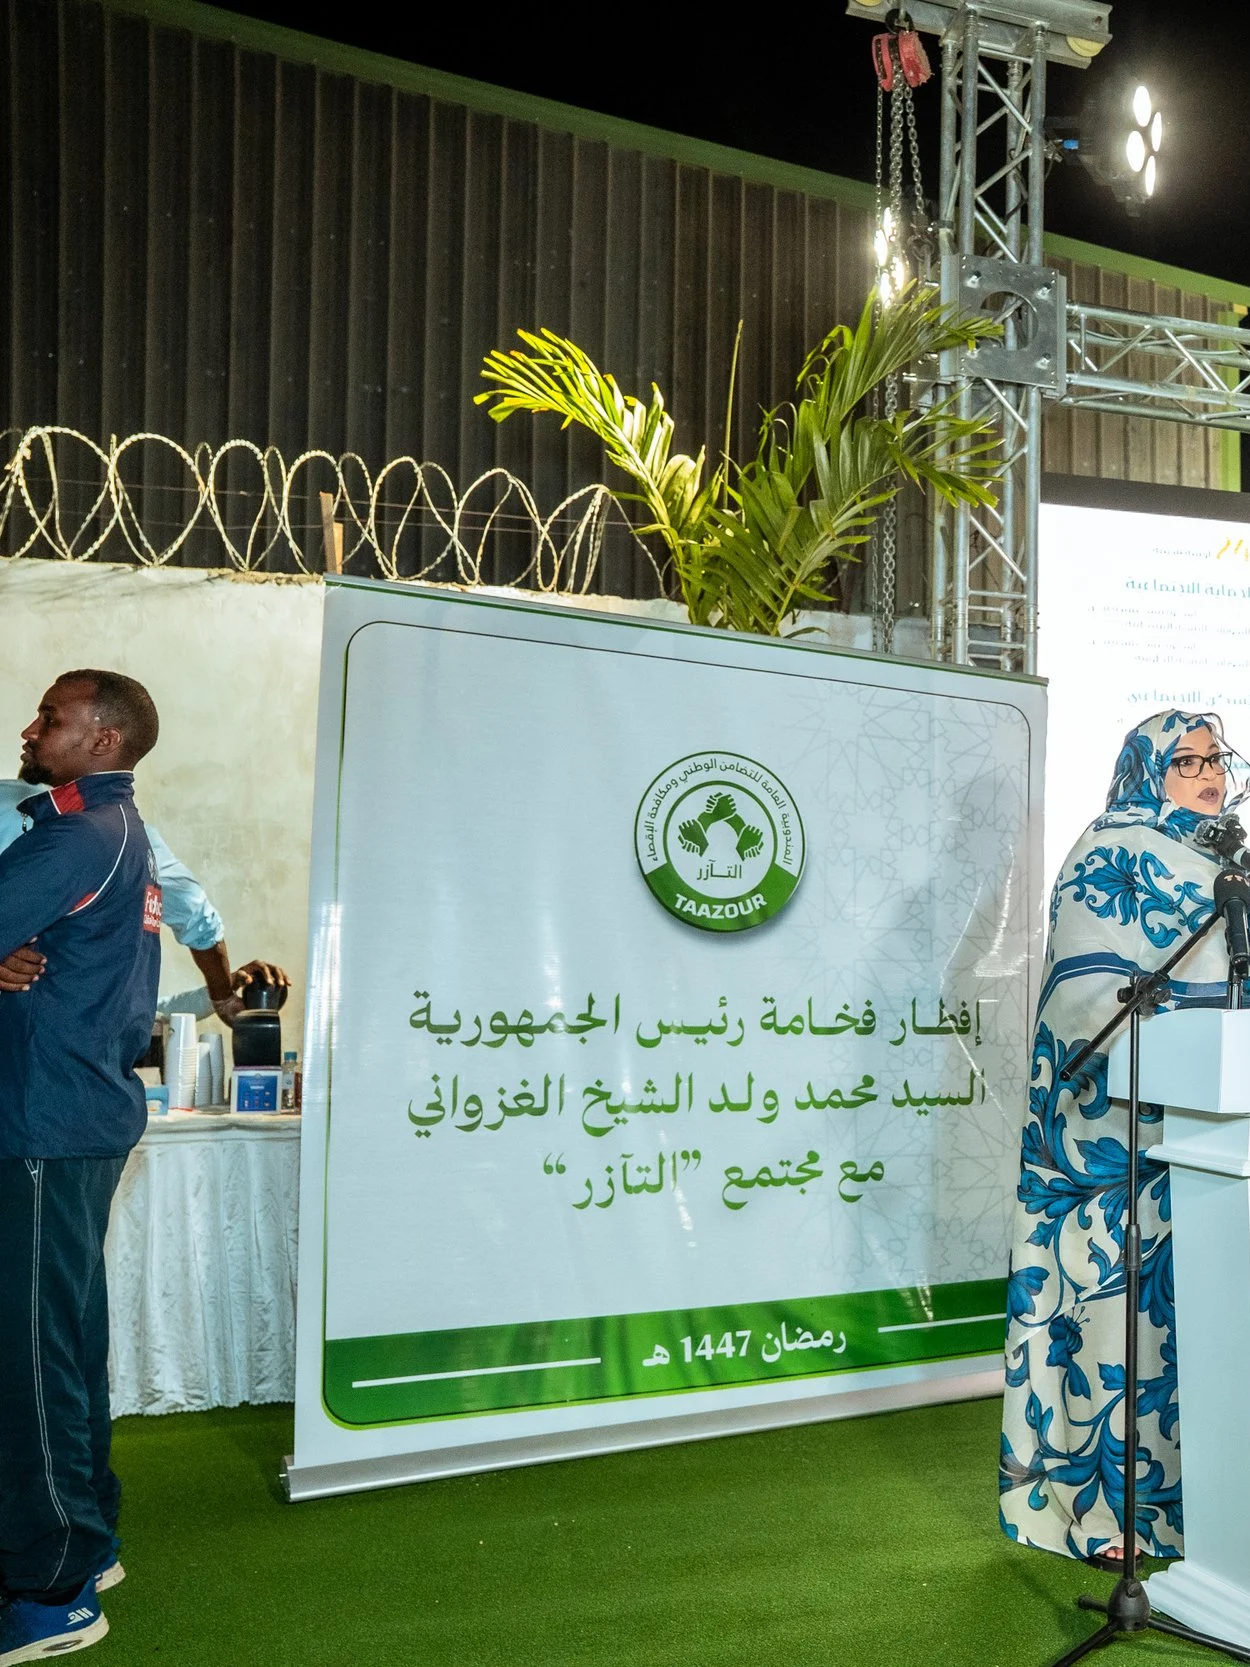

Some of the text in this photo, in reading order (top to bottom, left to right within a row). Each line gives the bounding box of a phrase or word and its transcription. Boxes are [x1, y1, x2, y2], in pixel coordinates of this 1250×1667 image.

[644, 758, 793, 866] المندوبية العامة للتضامن الوطني ومكافحة الإقصاء
[696, 859, 742, 880] التآزر
[674, 893, 767, 919] TAAZOUR
[408, 990, 982, 1049] إفطار فخامة رئيس الجمهورية
[408, 1068, 985, 1139] السيد محمد ولد الشيخ الغزواني
[721, 1149, 824, 1210] مجتمع
[837, 1157, 885, 1203] مع
[680, 1331, 751, 1364] 1447
[761, 1321, 847, 1365] رمضان
